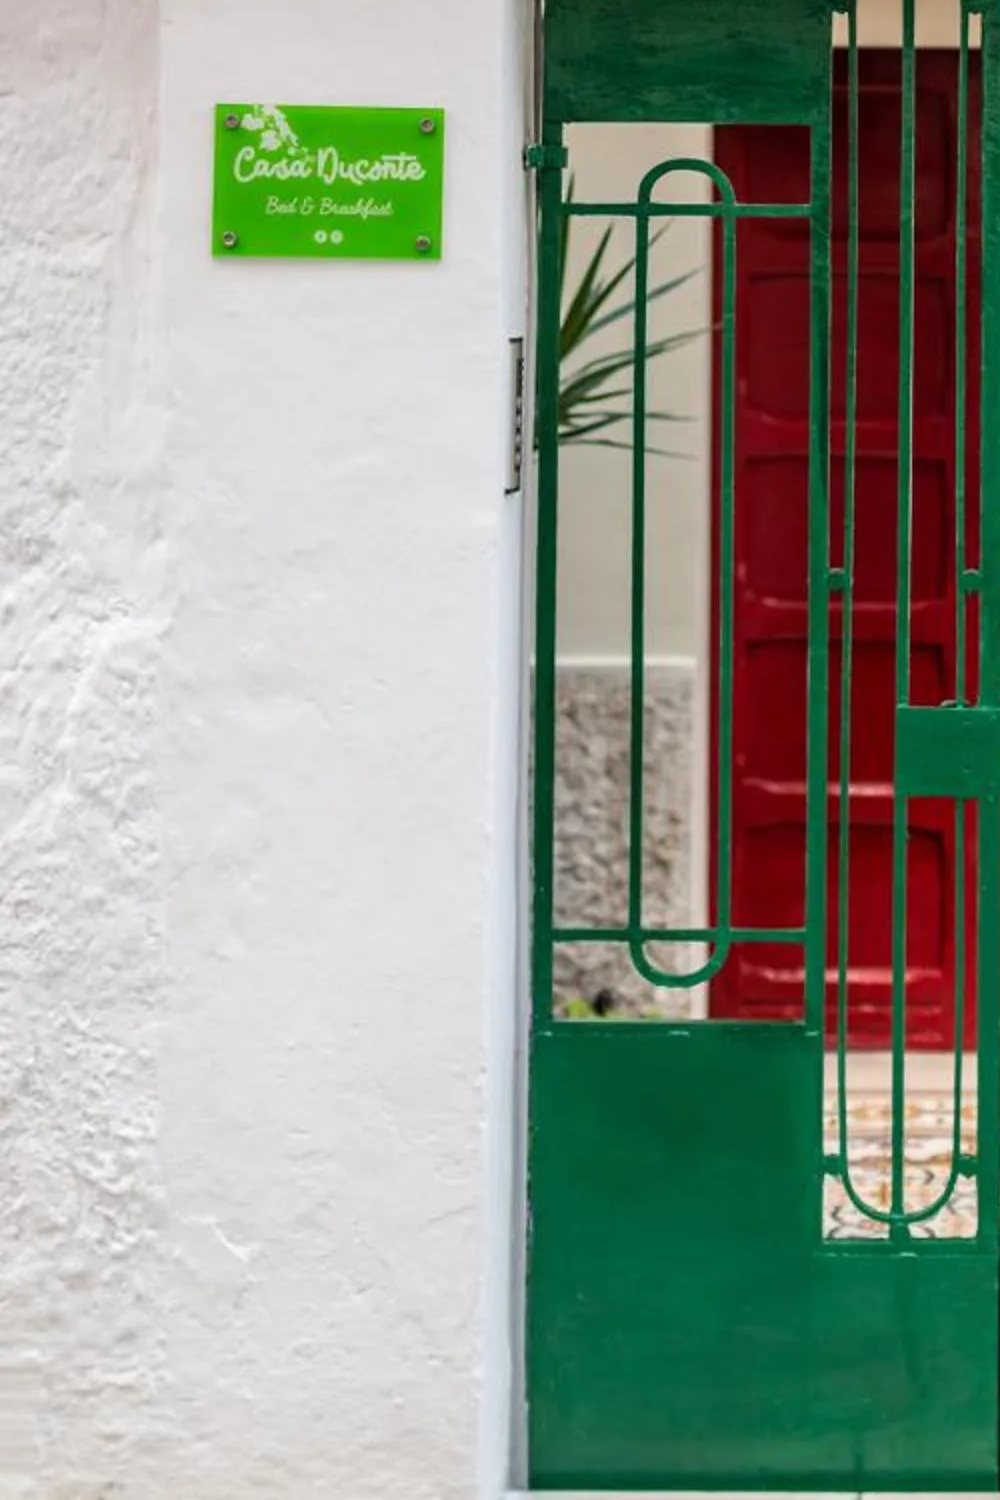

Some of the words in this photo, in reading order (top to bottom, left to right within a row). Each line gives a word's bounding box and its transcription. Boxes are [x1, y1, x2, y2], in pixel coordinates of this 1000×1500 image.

[233, 146, 311, 183] Casa
[266, 196, 297, 214] Bed
[300, 197, 315, 215] &
[319, 197, 394, 220] Breakfast
